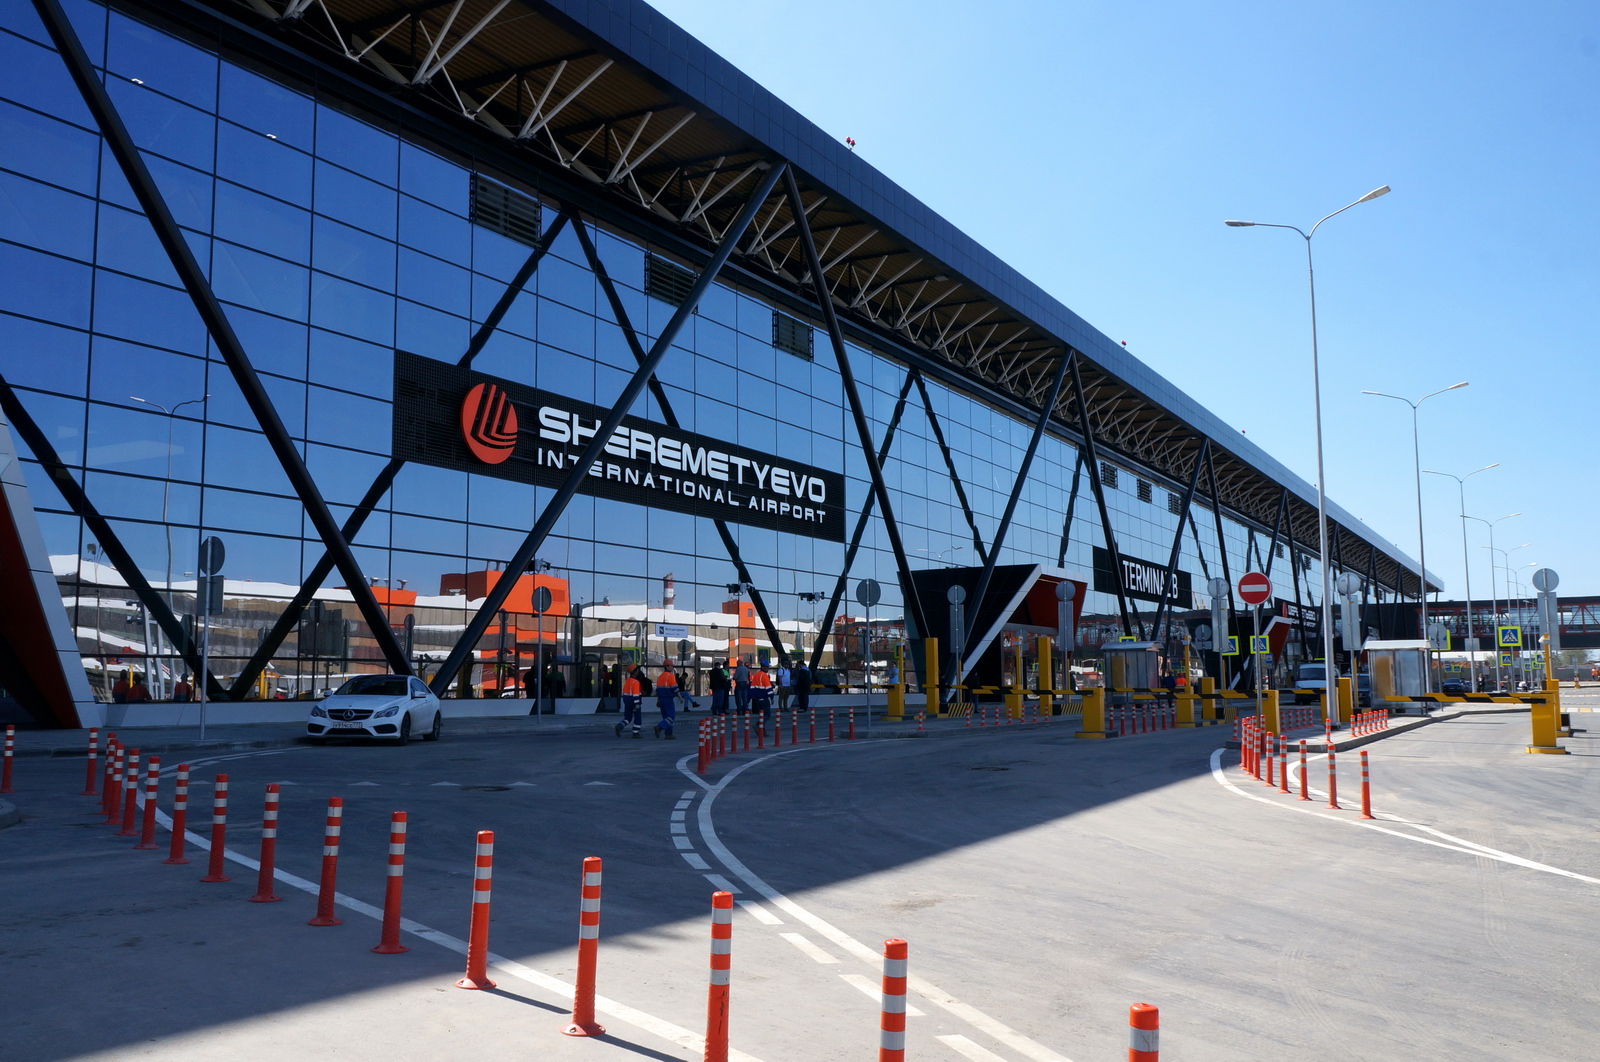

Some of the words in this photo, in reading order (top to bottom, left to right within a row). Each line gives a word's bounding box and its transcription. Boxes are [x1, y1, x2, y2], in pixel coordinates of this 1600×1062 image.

[536, 447, 741, 507] INTERNATIONAL
[748, 495, 827, 524] AIRPORT
[538, 406, 826, 504] SHEREMETYEVO
[1172, 573, 1179, 599] B
